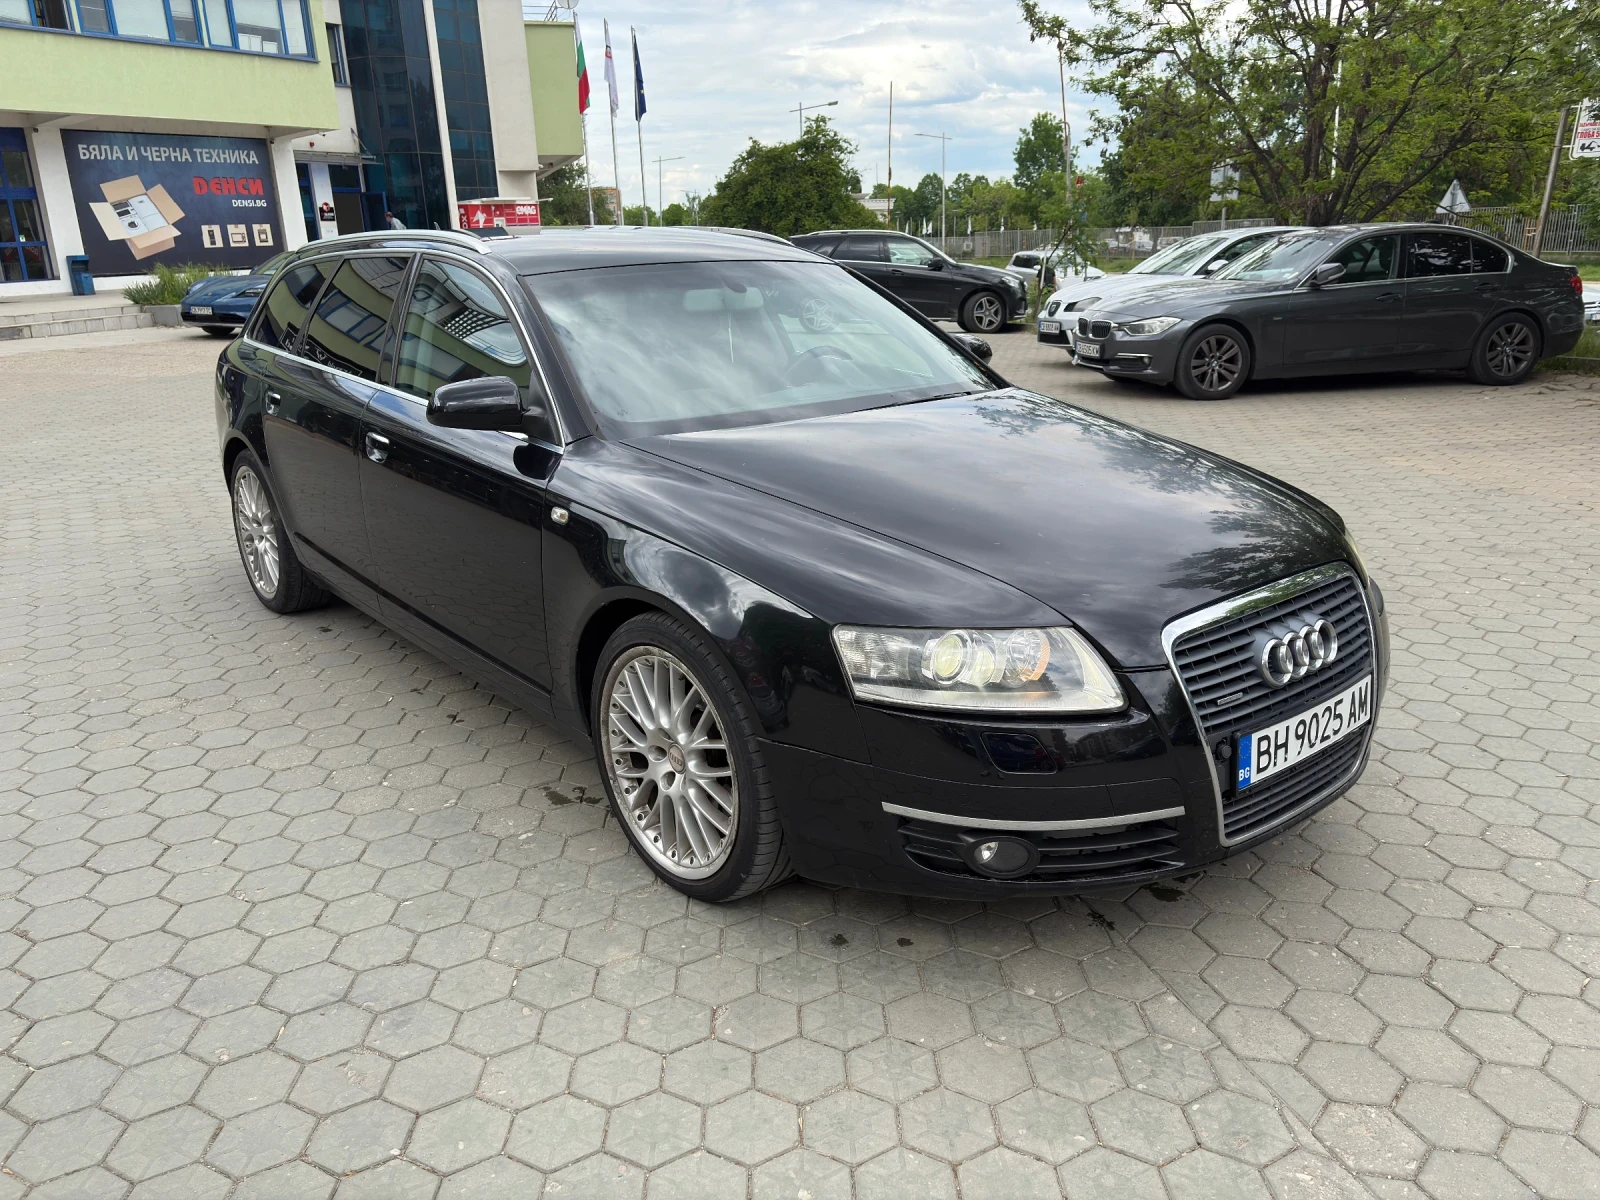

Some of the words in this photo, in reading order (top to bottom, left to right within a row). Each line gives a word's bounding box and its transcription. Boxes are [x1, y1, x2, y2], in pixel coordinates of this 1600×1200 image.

[78, 144, 123, 161] БЯЛА
[126, 146, 139, 161] И
[141, 146, 193, 162] ЧЕРНА
[193, 148, 259, 165] ТЕХНИКА
[232, 199, 267, 208] DENSI.BG
[1256, 725, 1290, 775] BH
[1294, 698, 1344, 756] 9025
[1347, 681, 1369, 729] AM
[1238, 767, 1250, 782] BG
